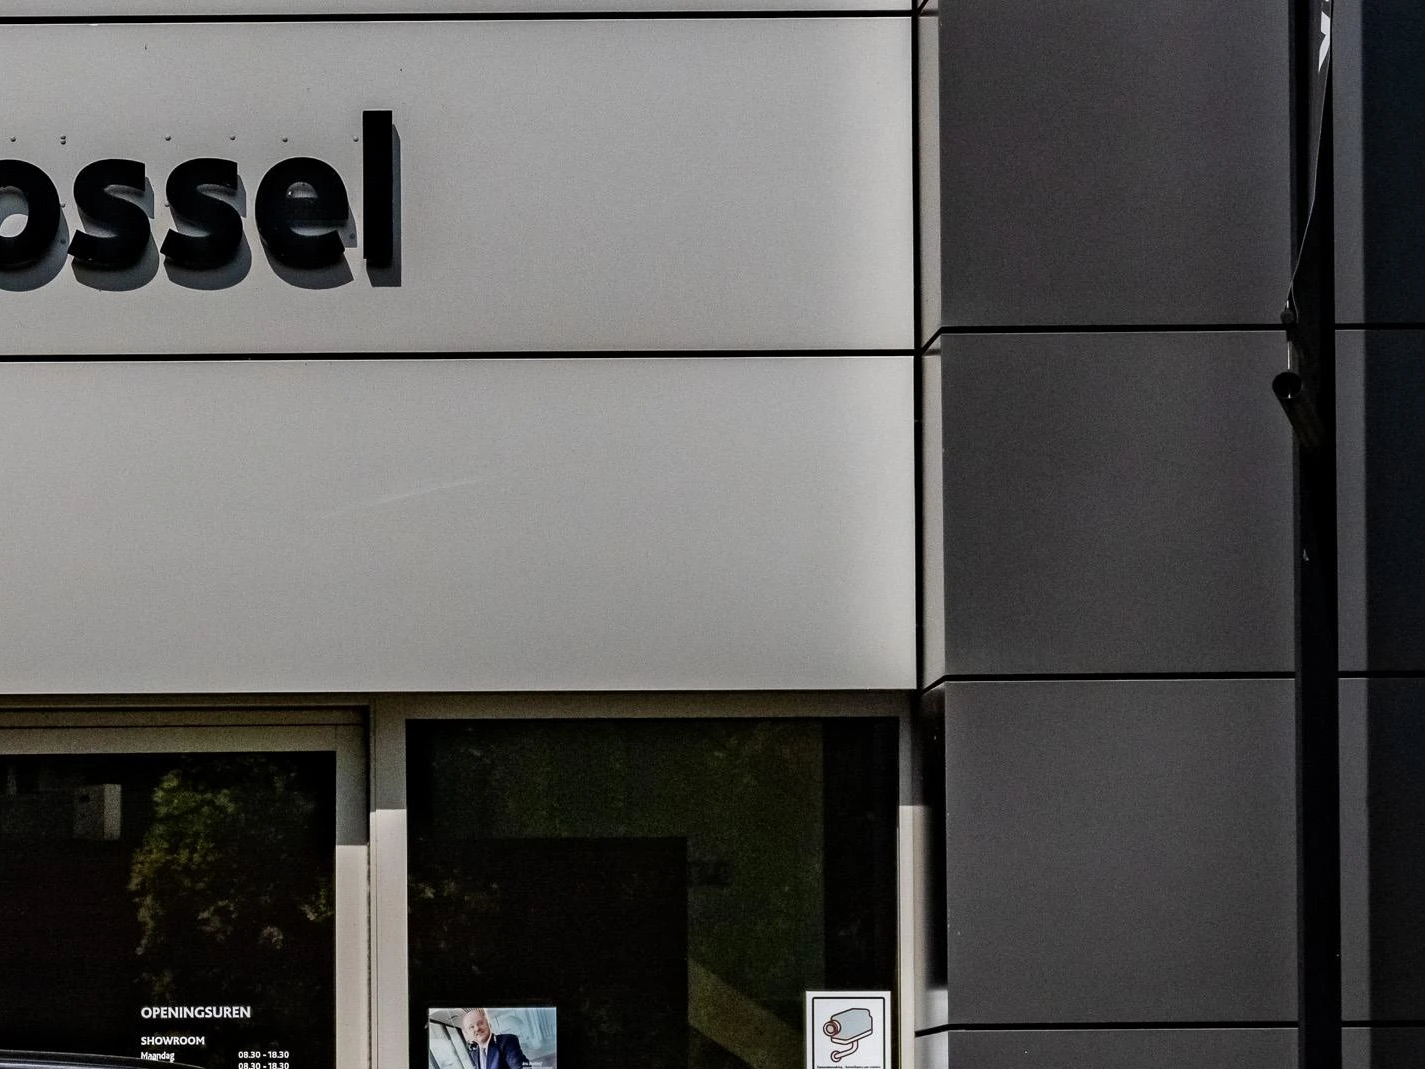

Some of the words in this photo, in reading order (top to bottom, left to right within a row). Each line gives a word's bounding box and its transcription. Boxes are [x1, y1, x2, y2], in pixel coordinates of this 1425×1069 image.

[140, 1006, 251, 1019] OPENINGSUREN
[140, 1036, 205, 1046] SHOWROOM
[140, 1051, 175, 1063] Maandag
[238, 1051, 261, 1059] 08.30
[267, 1051, 290, 1059] 18.30
